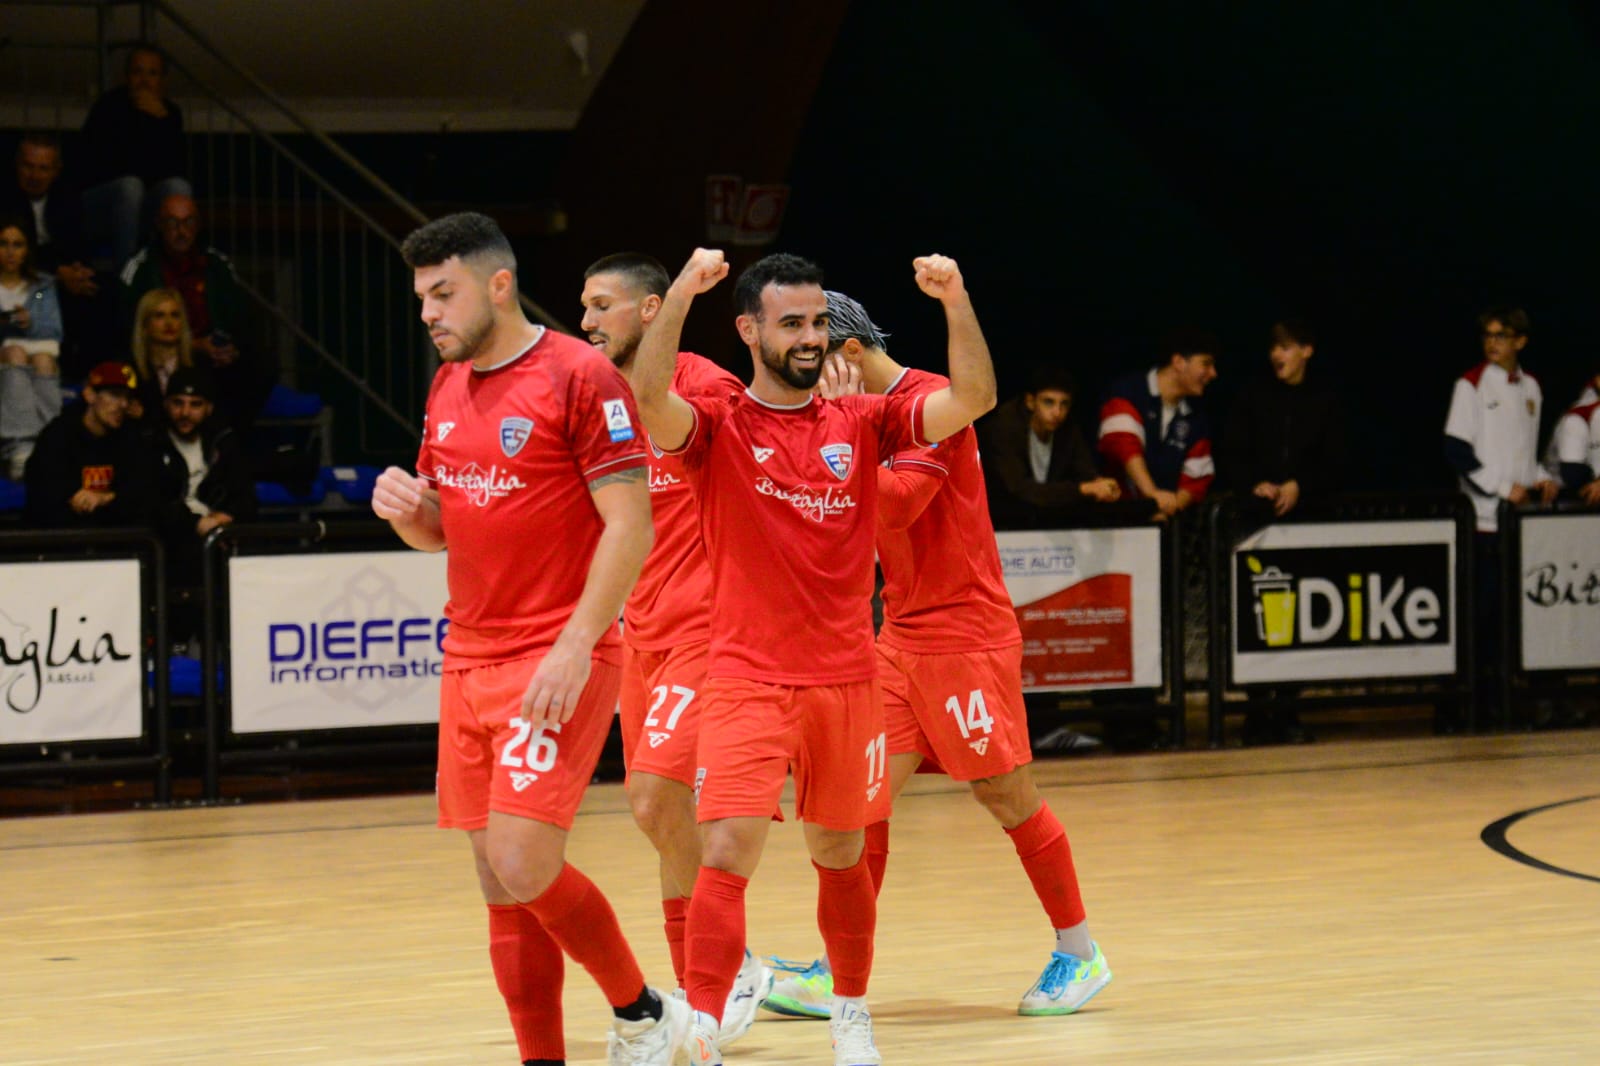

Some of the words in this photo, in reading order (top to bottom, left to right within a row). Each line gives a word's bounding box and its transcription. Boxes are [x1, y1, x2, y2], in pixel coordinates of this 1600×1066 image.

[1031, 555, 1075, 569] AUTO
[644, 685, 696, 731] 27
[945, 689, 994, 739] 14
[501, 717, 562, 772] 26
[865, 732, 886, 785] 11
